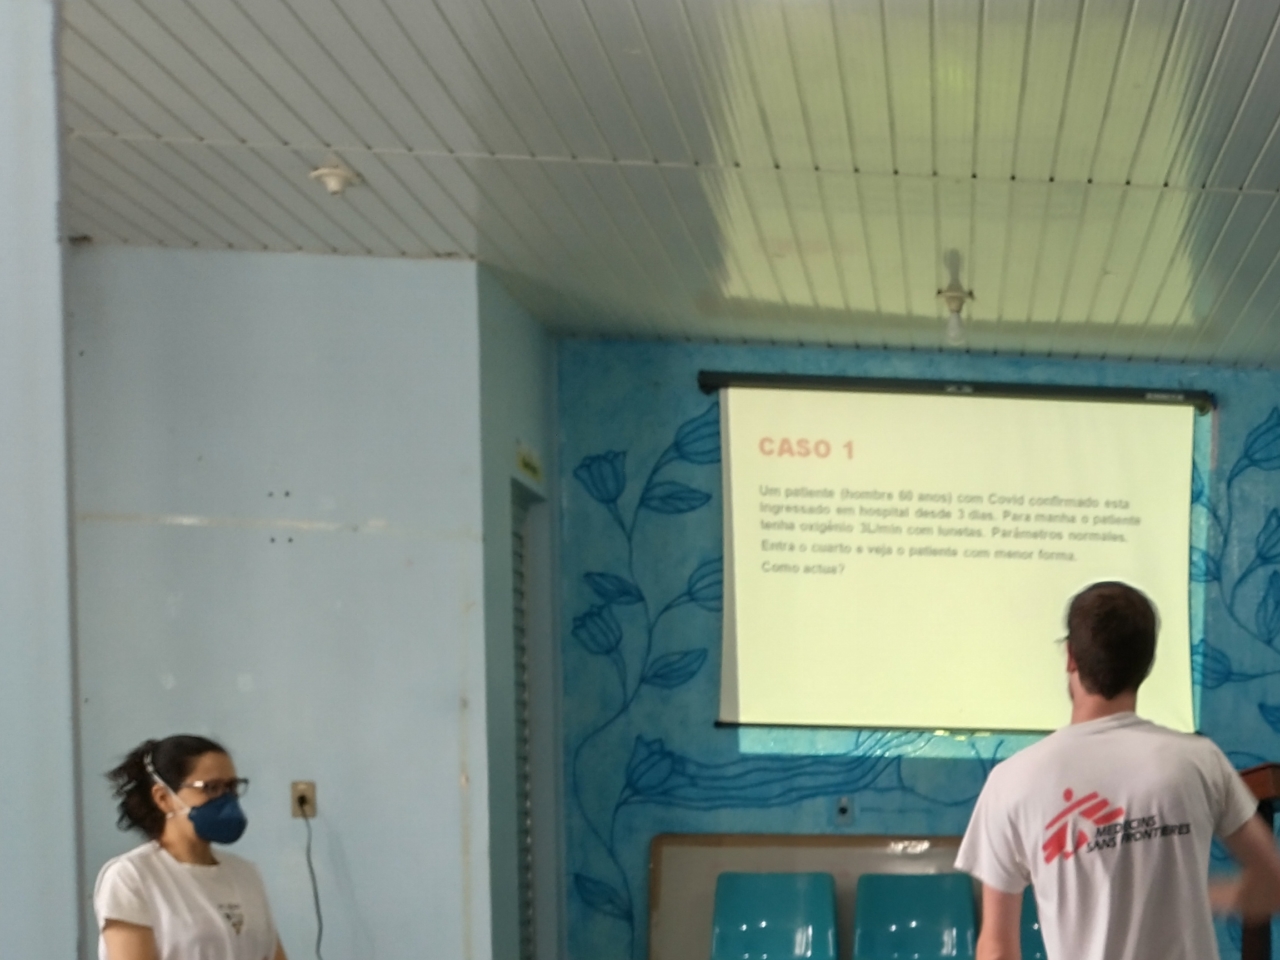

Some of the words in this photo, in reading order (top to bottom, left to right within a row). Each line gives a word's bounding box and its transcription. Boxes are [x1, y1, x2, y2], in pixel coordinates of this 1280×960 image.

[759, 437, 832, 459] CASO
[843, 440, 854, 460] 1
[759, 485, 781, 497] Um
[840, 488, 893, 501] (hombre
[917, 492, 952, 504] anos)
[957, 494, 983, 504] com
[988, 493, 1024, 506] Covid
[1028, 496, 1099, 509] confirmado
[836, 507, 855, 515] em
[859, 506, 909, 519] hospital
[915, 507, 951, 519] desde
[957, 509, 965, 520] 3
[968, 510, 995, 521] dias.
[1002, 510, 1031, 522] Para
[1081, 516, 1088, 524] o
[760, 520, 795, 530] tenha
[907, 526, 933, 535] com
[761, 540, 796, 551] Entra
[800, 544, 806, 552] o
[811, 543, 851, 553] cuarto
[897, 546, 904, 555] o
[962, 550, 990, 558] com
[761, 561, 800, 573] Como
[1087, 836, 1117, 853] SANS
